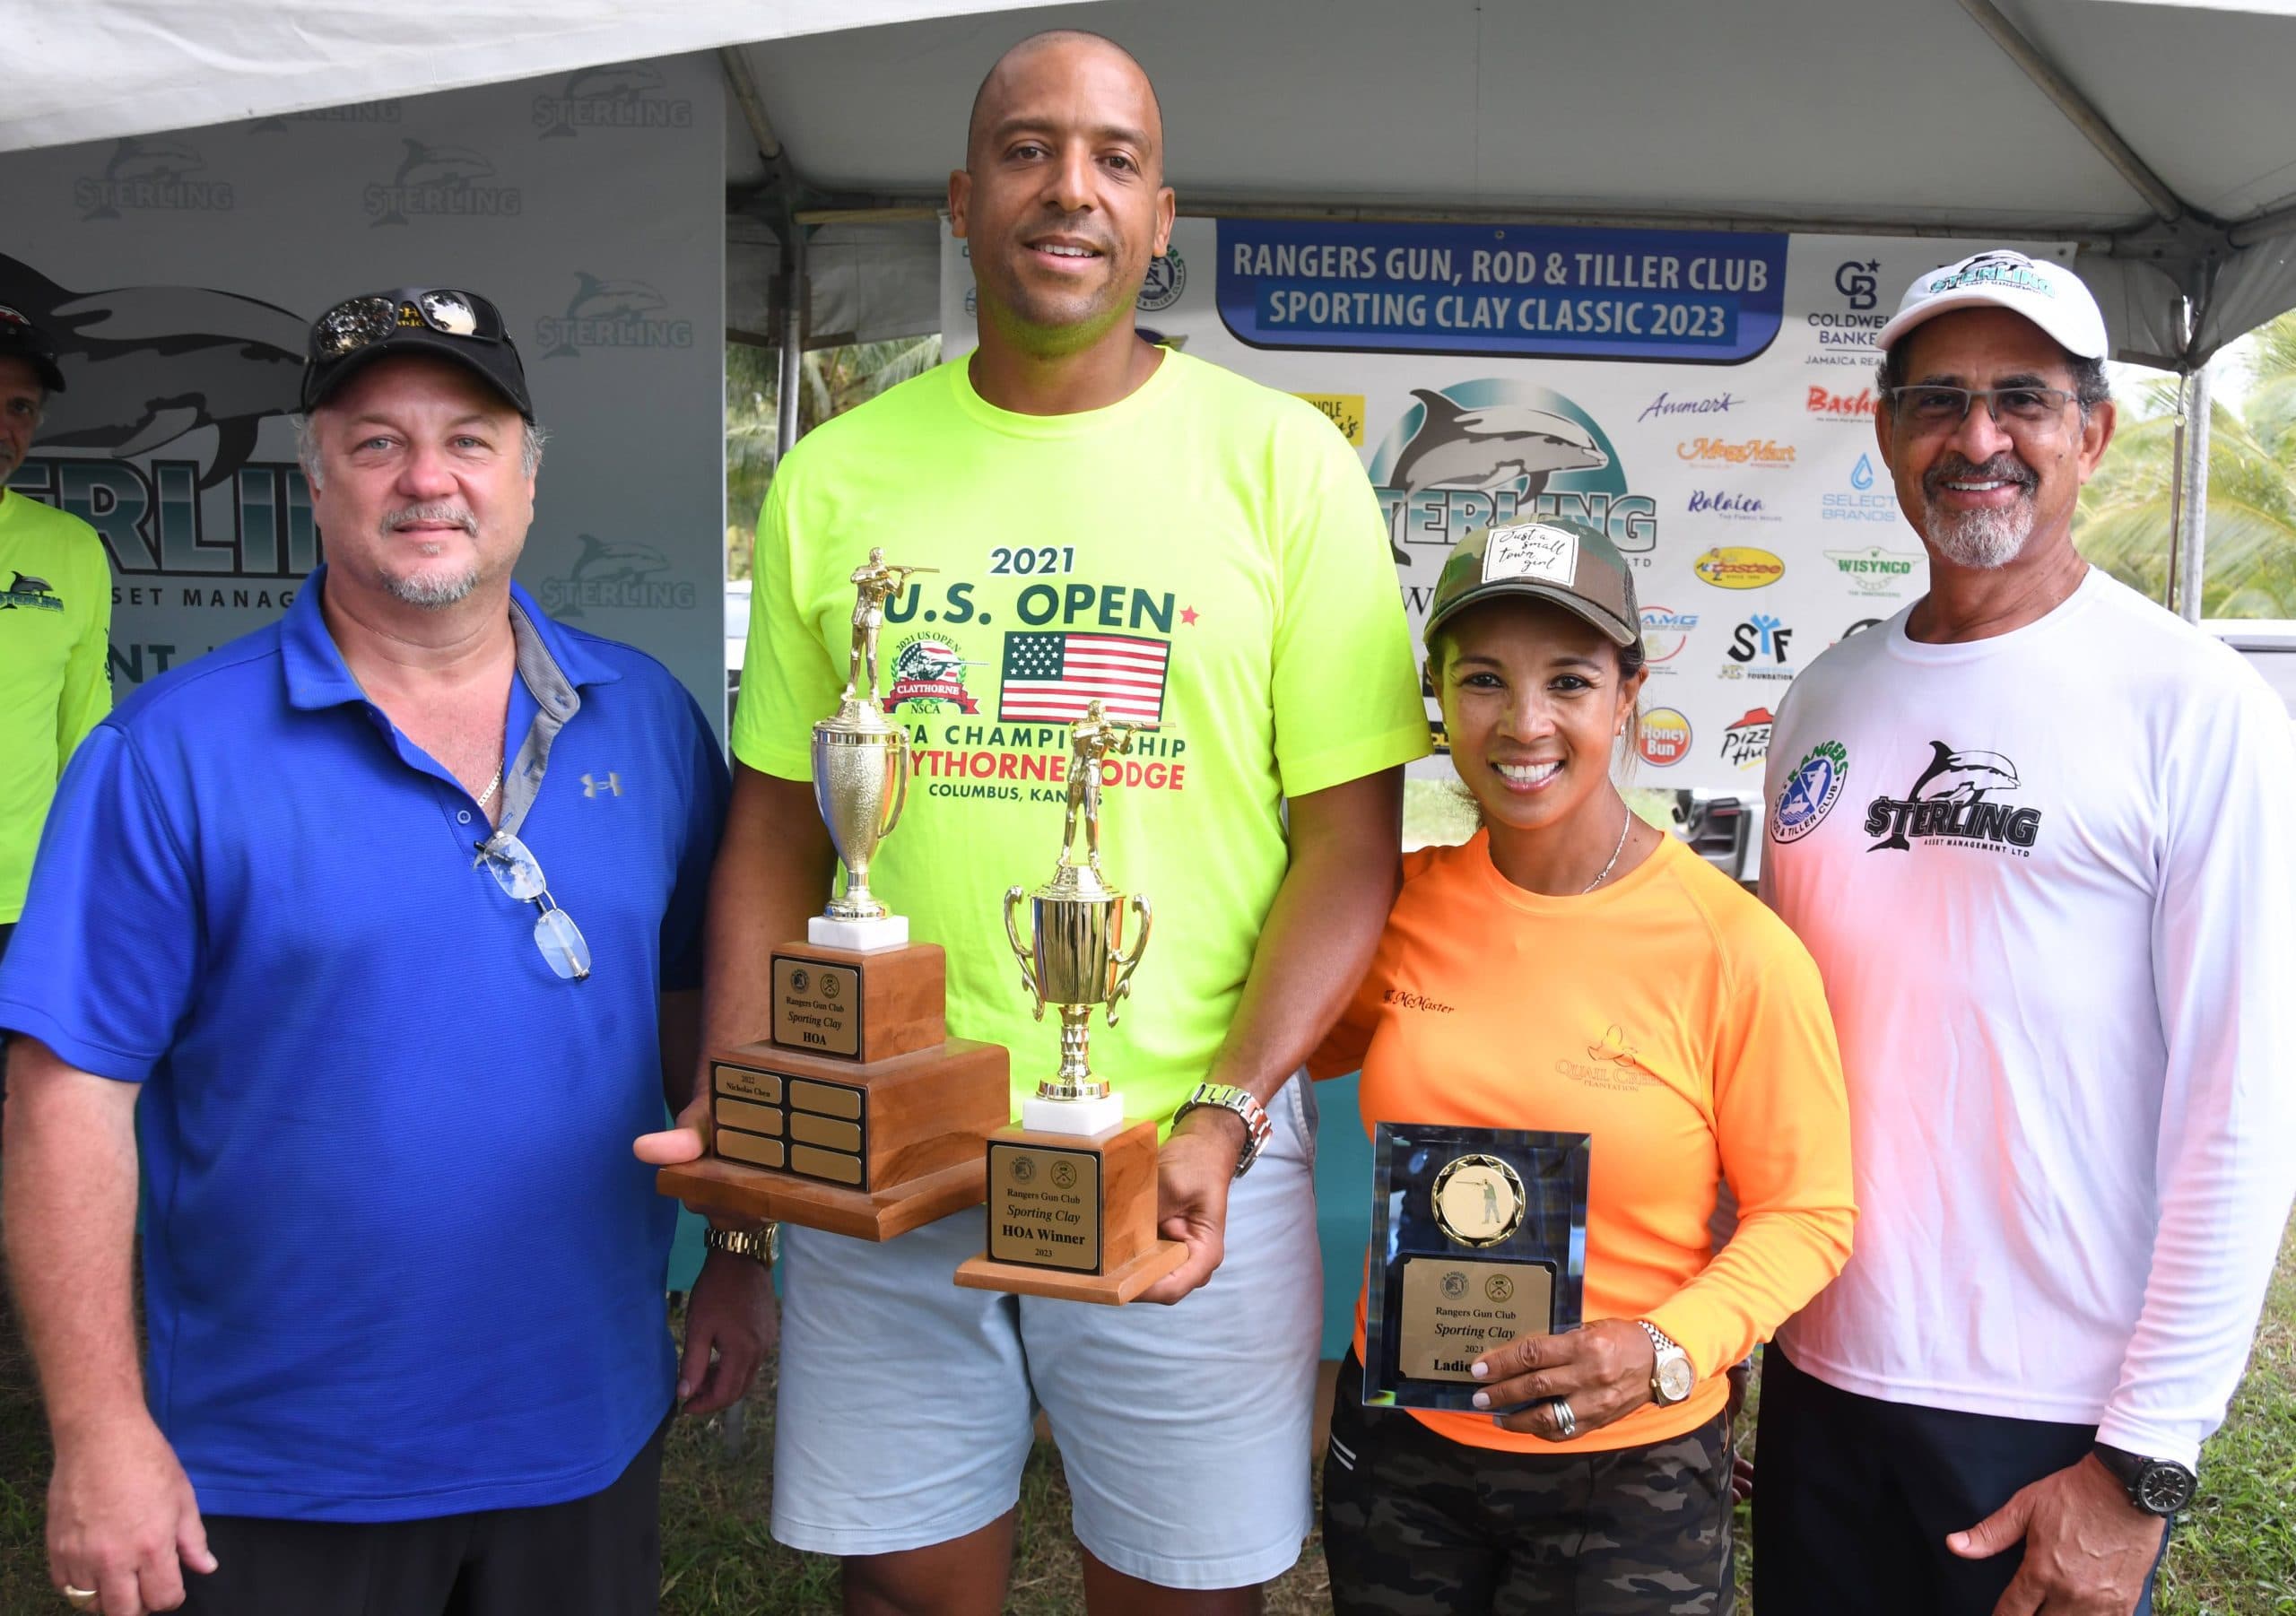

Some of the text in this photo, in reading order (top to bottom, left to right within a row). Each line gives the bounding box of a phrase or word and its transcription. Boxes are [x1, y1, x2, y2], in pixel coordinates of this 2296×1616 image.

[1233, 243, 1768, 291] RANGERS GUN, ROD & TILLER CLUB
[1269, 291, 1725, 337] SPORTING CLAY CLASSIC 2023
[1808, 313, 1890, 329] COLDWE
[1820, 330, 1877, 345] BANKE
[1805, 355, 1856, 366] JAMAICA
[1822, 493, 1896, 508] SELECT
[1822, 508, 1895, 521] BRANDS
[1500, 528, 1535, 543] Just
[1500, 547, 1535, 563] town
[1522, 540, 1565, 555] small
[990, 547, 1074, 575] 2021
[1521, 557, 1555, 572] girl
[1839, 560, 1911, 574] WISYNCO
[884, 583, 1176, 633] U.S. OPEN
[918, 631, 931, 640] US
[897, 684, 960, 695] CLAYTHORNE
[911, 704, 941, 714] NSCA
[1641, 723, 1686, 745] Honey
[1648, 741, 1675, 756] Bun
[1721, 729, 1770, 758] Pizz
[1101, 759, 1185, 790] ODGE
[928, 783, 1023, 802] COLUMBUS,
[1788, 813, 1817, 837] TILLER
[1818, 786, 1837, 814] CLUB
[1924, 838, 2030, 857] ASSET MANAGEMENT LTD
[786, 996, 844, 1012] Rangers Gun Club
[1393, 991, 1455, 1013] McMaster
[788, 1012, 842, 1030] Sporting Clay
[803, 1032, 826, 1046] HOA
[1584, 1081, 1639, 1091] PLANTATION
[1007, 1188, 1081, 1204] Rangers Gun Club
[1006, 1204, 1081, 1225] Sporting Clay
[1003, 1224, 1085, 1245] HOA Winner
[1035, 1248, 1053, 1256] 2023
[1435, 1307, 1517, 1319] Rangers Gun Club
[1435, 1323, 1516, 1341] Sporting Clay
[1465, 1345, 1484, 1353] 2023
[1434, 1359, 1472, 1372] Ladie
